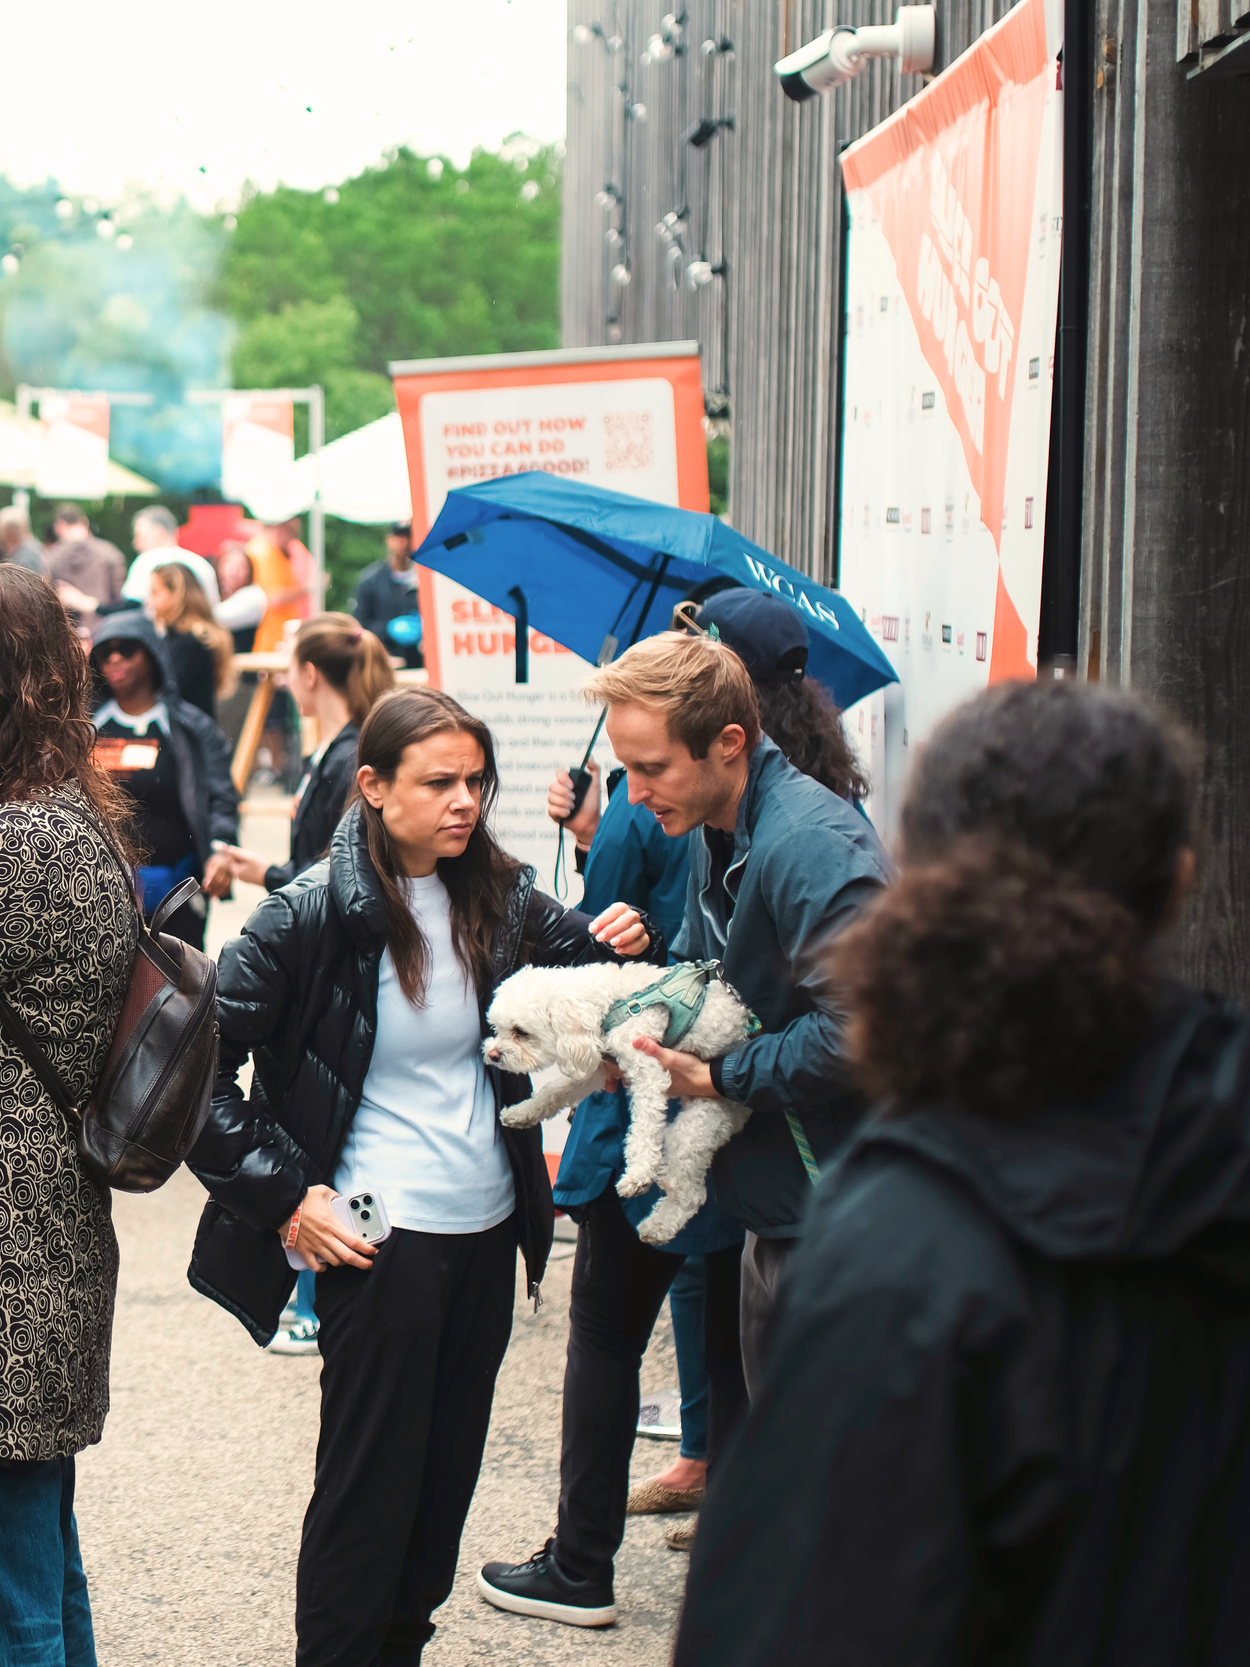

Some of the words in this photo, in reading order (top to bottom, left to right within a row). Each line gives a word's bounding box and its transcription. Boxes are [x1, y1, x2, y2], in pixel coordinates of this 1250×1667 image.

[972, 257, 1015, 402] OUT
[444, 423, 487, 437] FIND
[493, 419, 531, 435] OUT
[539, 417, 586, 431] HOW
[447, 443, 484, 458] YOU
[491, 441, 532, 456] CAN
[539, 439, 565, 454] DO
